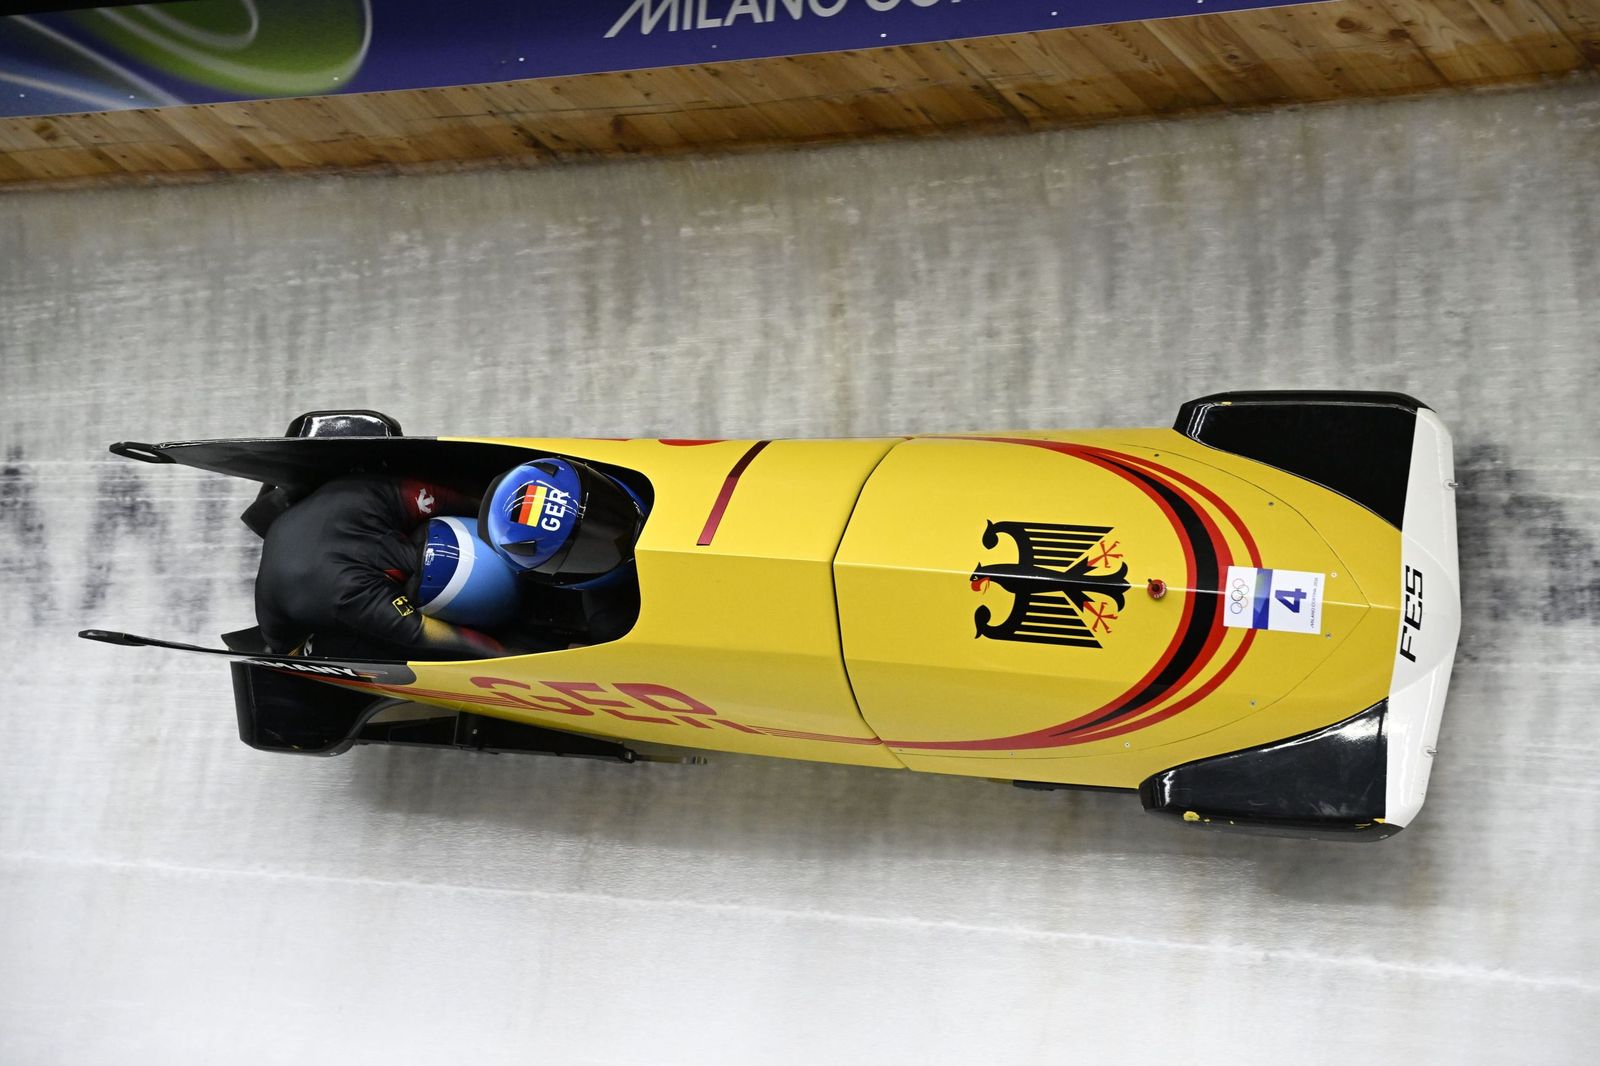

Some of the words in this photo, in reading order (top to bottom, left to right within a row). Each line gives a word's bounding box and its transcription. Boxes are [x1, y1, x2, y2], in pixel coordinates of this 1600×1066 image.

[541, 488, 569, 532] GER
[1275, 588, 1307, 614] 4
[1399, 565, 1423, 663] FES
